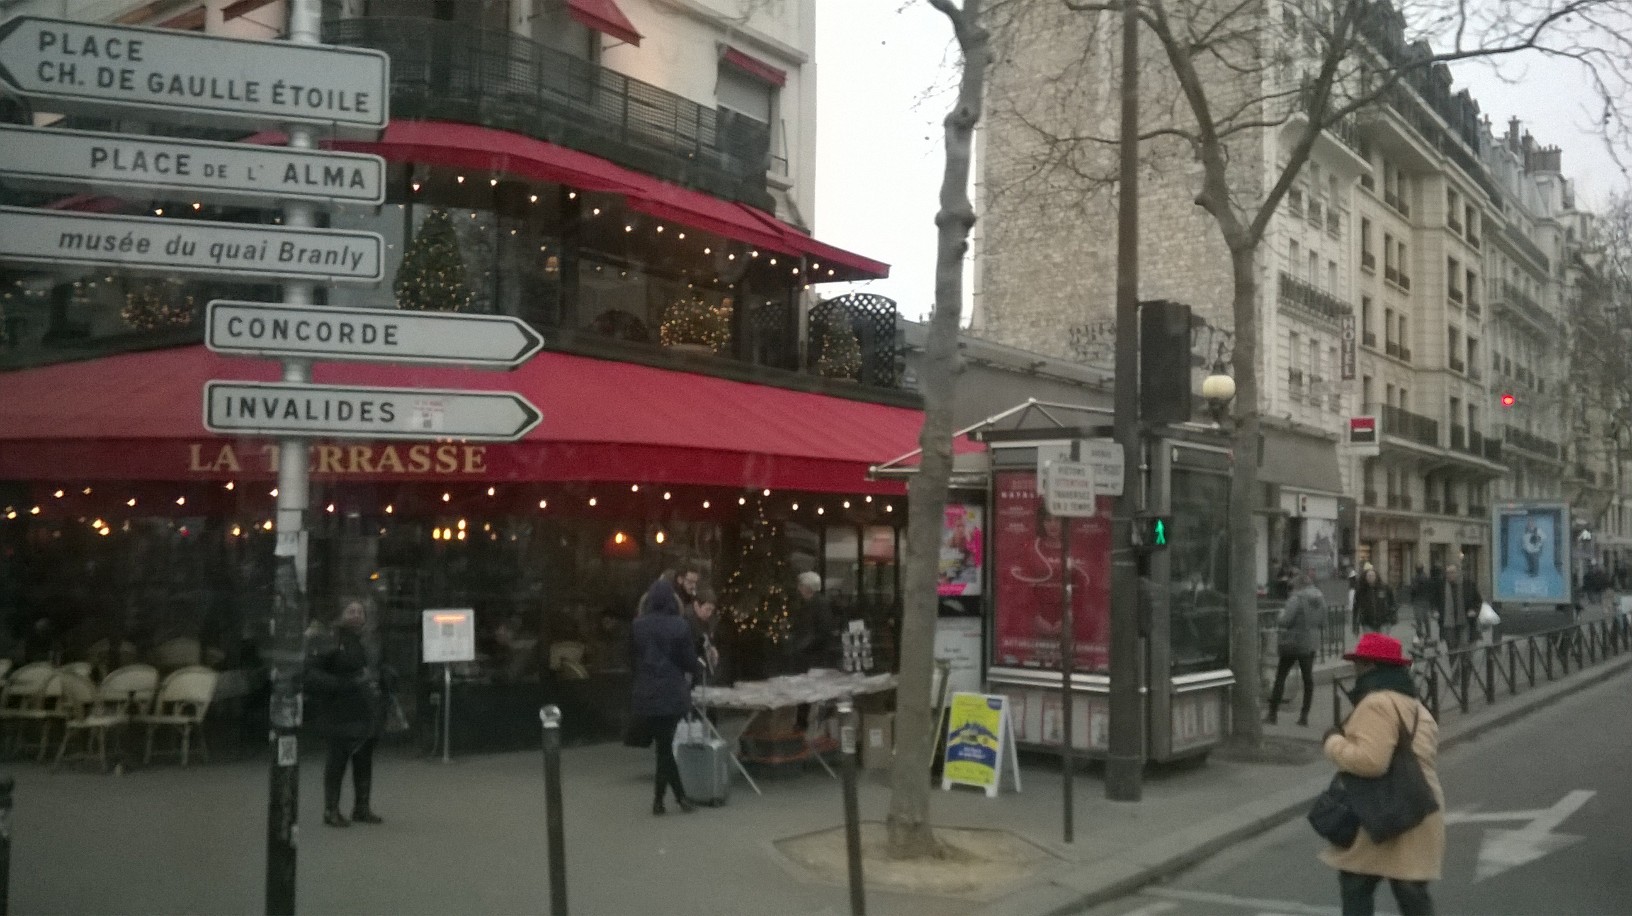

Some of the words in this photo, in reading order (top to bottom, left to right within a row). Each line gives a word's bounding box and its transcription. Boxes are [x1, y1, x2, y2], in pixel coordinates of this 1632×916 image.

[38, 31, 143, 62] PLACE
[37, 61, 85, 86] CH.
[97, 66, 135, 91] DE
[147, 75, 260, 102] GAULLE
[272, 79, 371, 114] ÉTOILE
[90, 147, 191, 176] PLACE
[203, 163, 228, 179] DE
[282, 164, 366, 190] ALMA
[58, 228, 150, 256] musée
[165, 234, 196, 257] du
[211, 240, 267, 264] quai
[279, 240, 364, 270] Branly
[228, 317, 398, 346] CONCORDE
[226, 396, 395, 422] INVALIDES
[189, 444, 240, 472] LA
[263, 444, 487, 474] TRRASSE
